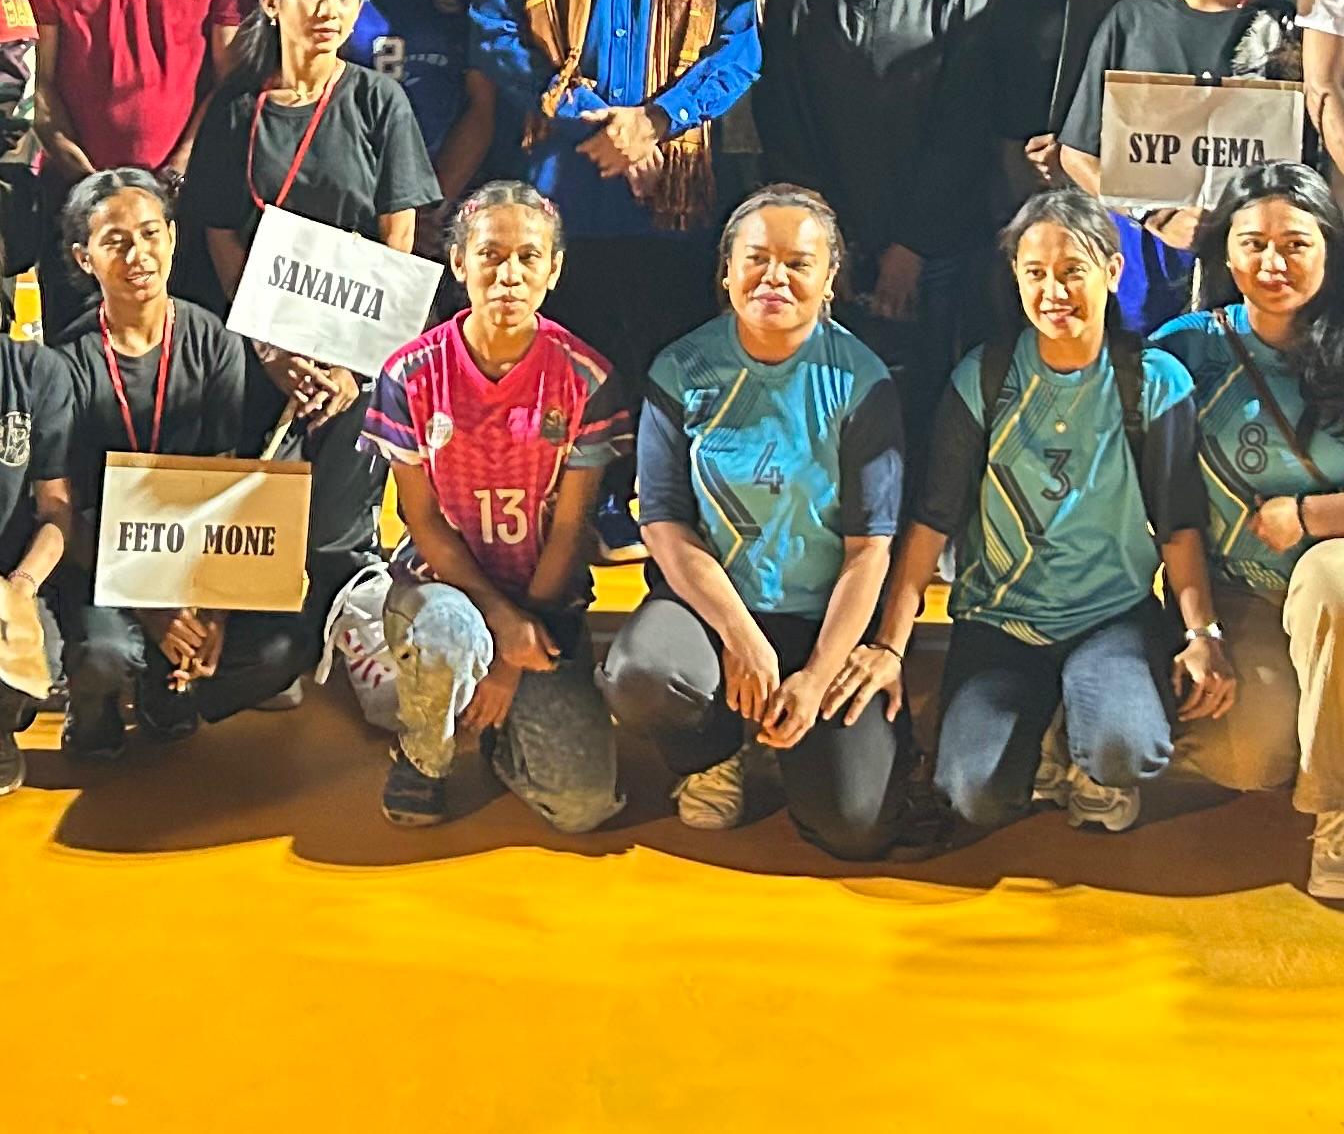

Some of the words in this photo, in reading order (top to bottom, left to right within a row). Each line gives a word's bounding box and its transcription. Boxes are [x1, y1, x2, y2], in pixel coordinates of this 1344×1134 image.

[1129, 132, 1181, 164] SYP
[1192, 135, 1266, 168] GEMA
[267, 255, 384, 321] SANANTA
[752, 441, 784, 495] 4
[1041, 449, 1072, 501] 3
[1235, 422, 1268, 475] 8
[117, 521, 185, 553] FETO
[202, 524, 276, 556] MONE
[473, 488, 528, 545] 13
